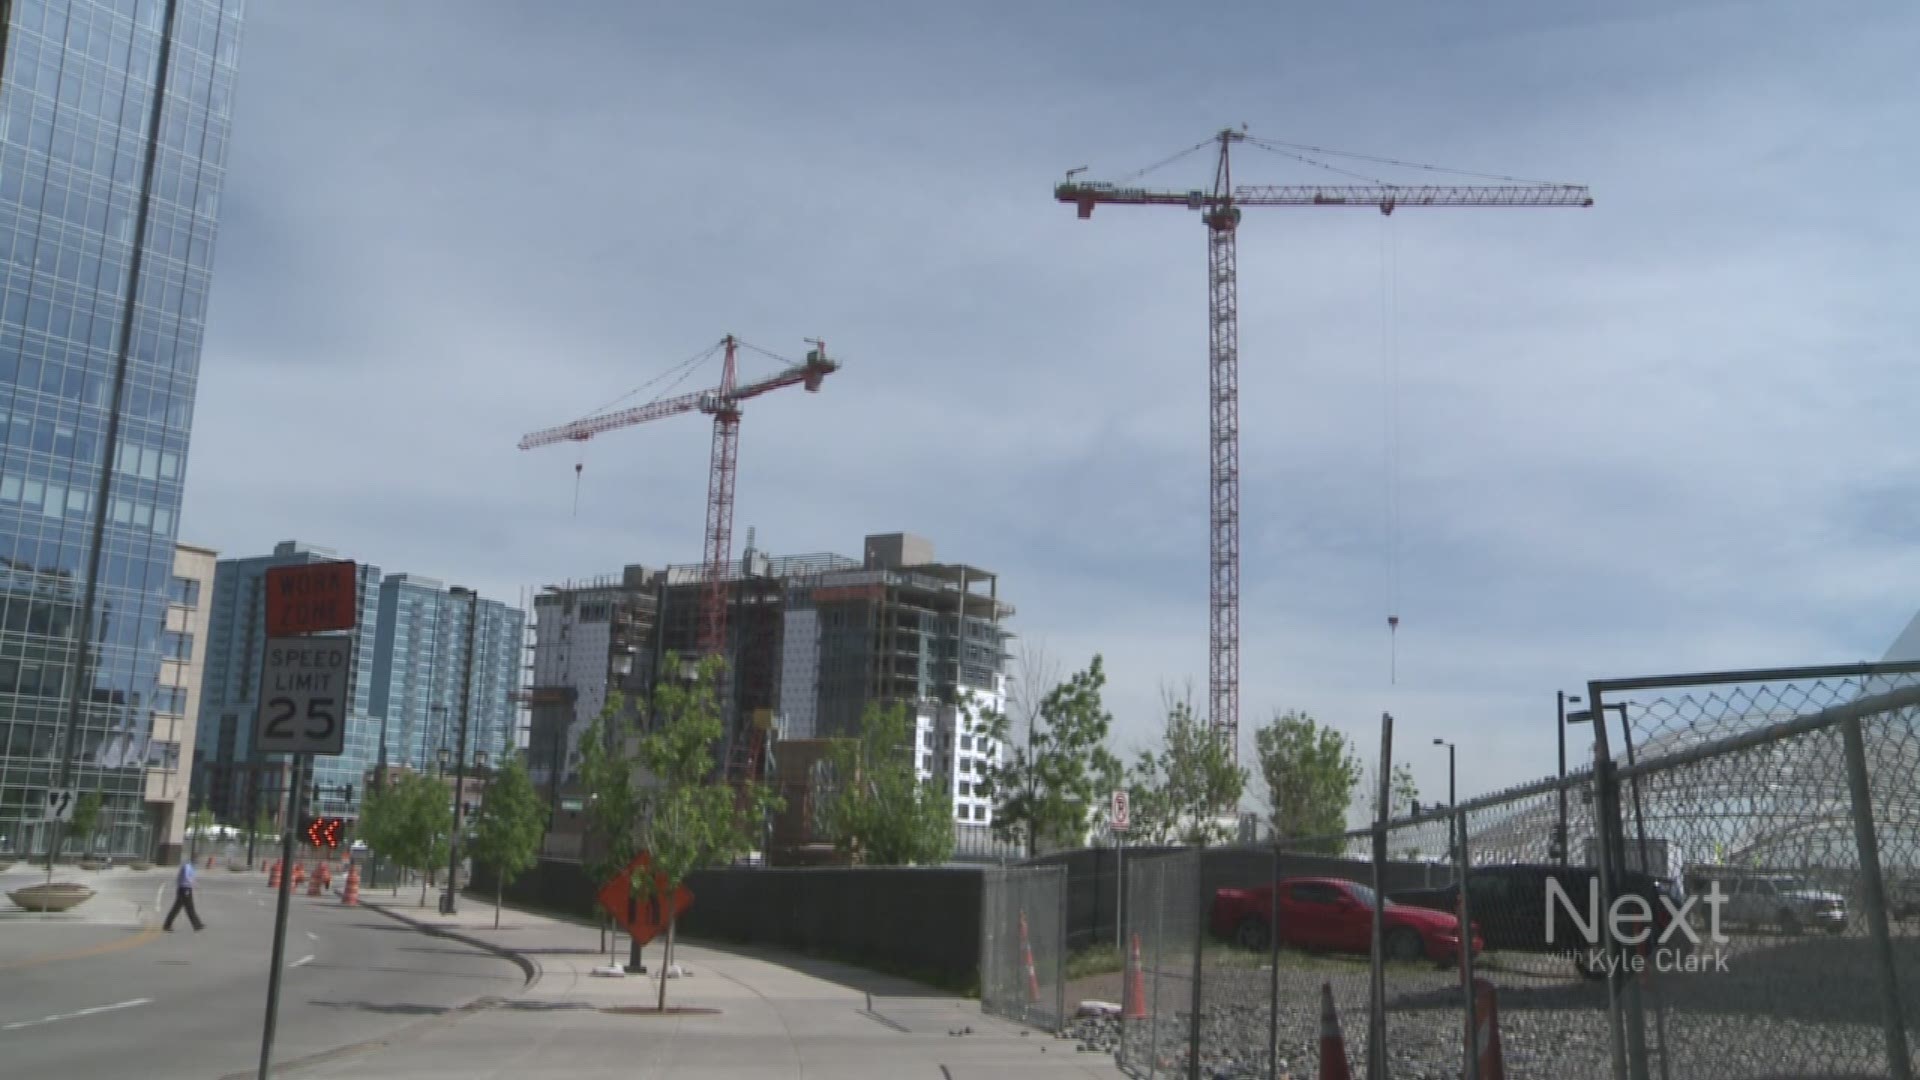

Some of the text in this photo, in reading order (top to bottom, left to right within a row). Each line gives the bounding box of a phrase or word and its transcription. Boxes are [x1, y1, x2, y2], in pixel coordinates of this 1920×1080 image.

[280, 572, 340, 594] WORK
[280, 602, 338, 625] ZONE
[271, 648, 342, 667] SPEED
[275, 673, 332, 691] LIMIT
[264, 697, 336, 739] 25
